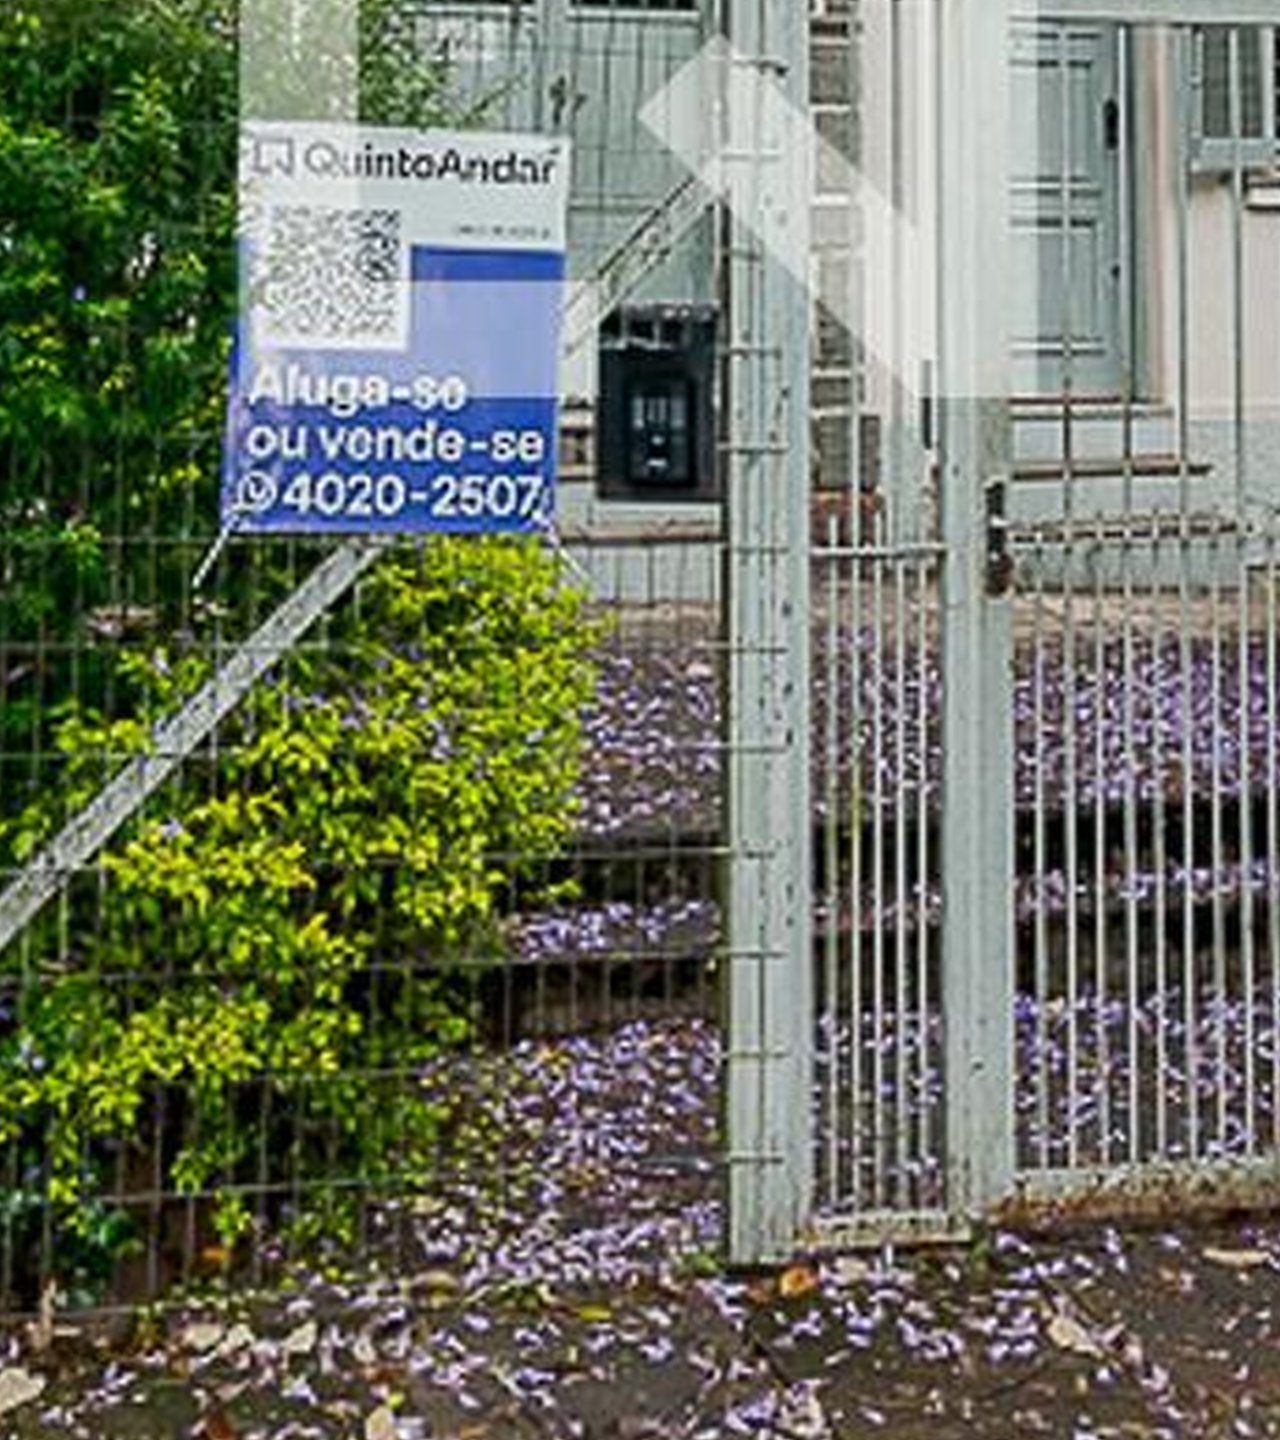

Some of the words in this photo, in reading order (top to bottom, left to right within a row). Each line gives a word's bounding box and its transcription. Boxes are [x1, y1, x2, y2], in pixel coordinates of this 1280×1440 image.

[305, 142, 557, 183] QuintoAndar
[249, 363, 466, 417] Aluga-se
[247, 424, 308, 459] ou
[320, 420, 544, 462] vende-se
[282, 474, 543, 517] 4020-2507
